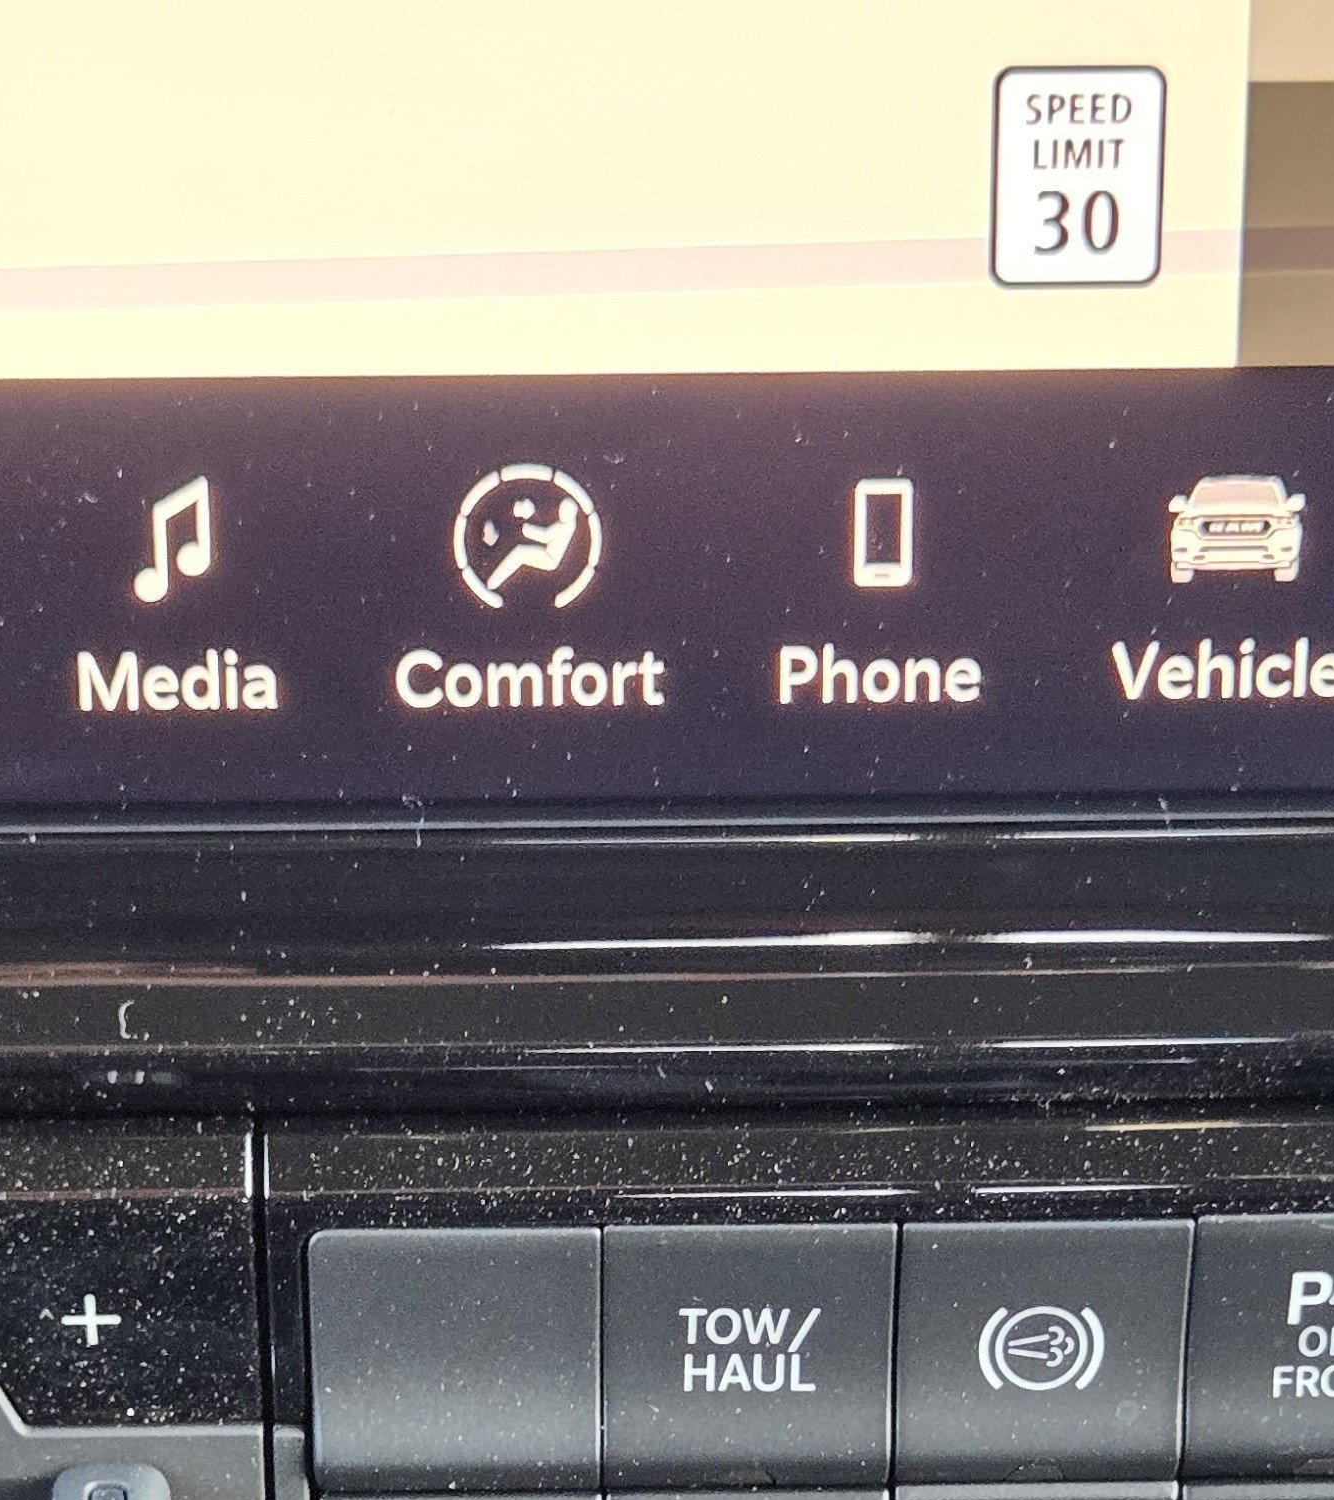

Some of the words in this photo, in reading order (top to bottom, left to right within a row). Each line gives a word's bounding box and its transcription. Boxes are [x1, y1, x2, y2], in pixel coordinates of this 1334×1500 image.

[1026, 93, 1132, 125] SPEED
[1033, 138, 1125, 170] LIMIT
[1034, 190, 1120, 255] 30
[77, 648, 279, 712] Media
[395, 645, 666, 709] Comfort
[779, 642, 982, 705] Phone
[678, 1307, 822, 1353] TOW/
[683, 1353, 817, 1393] HAUL
